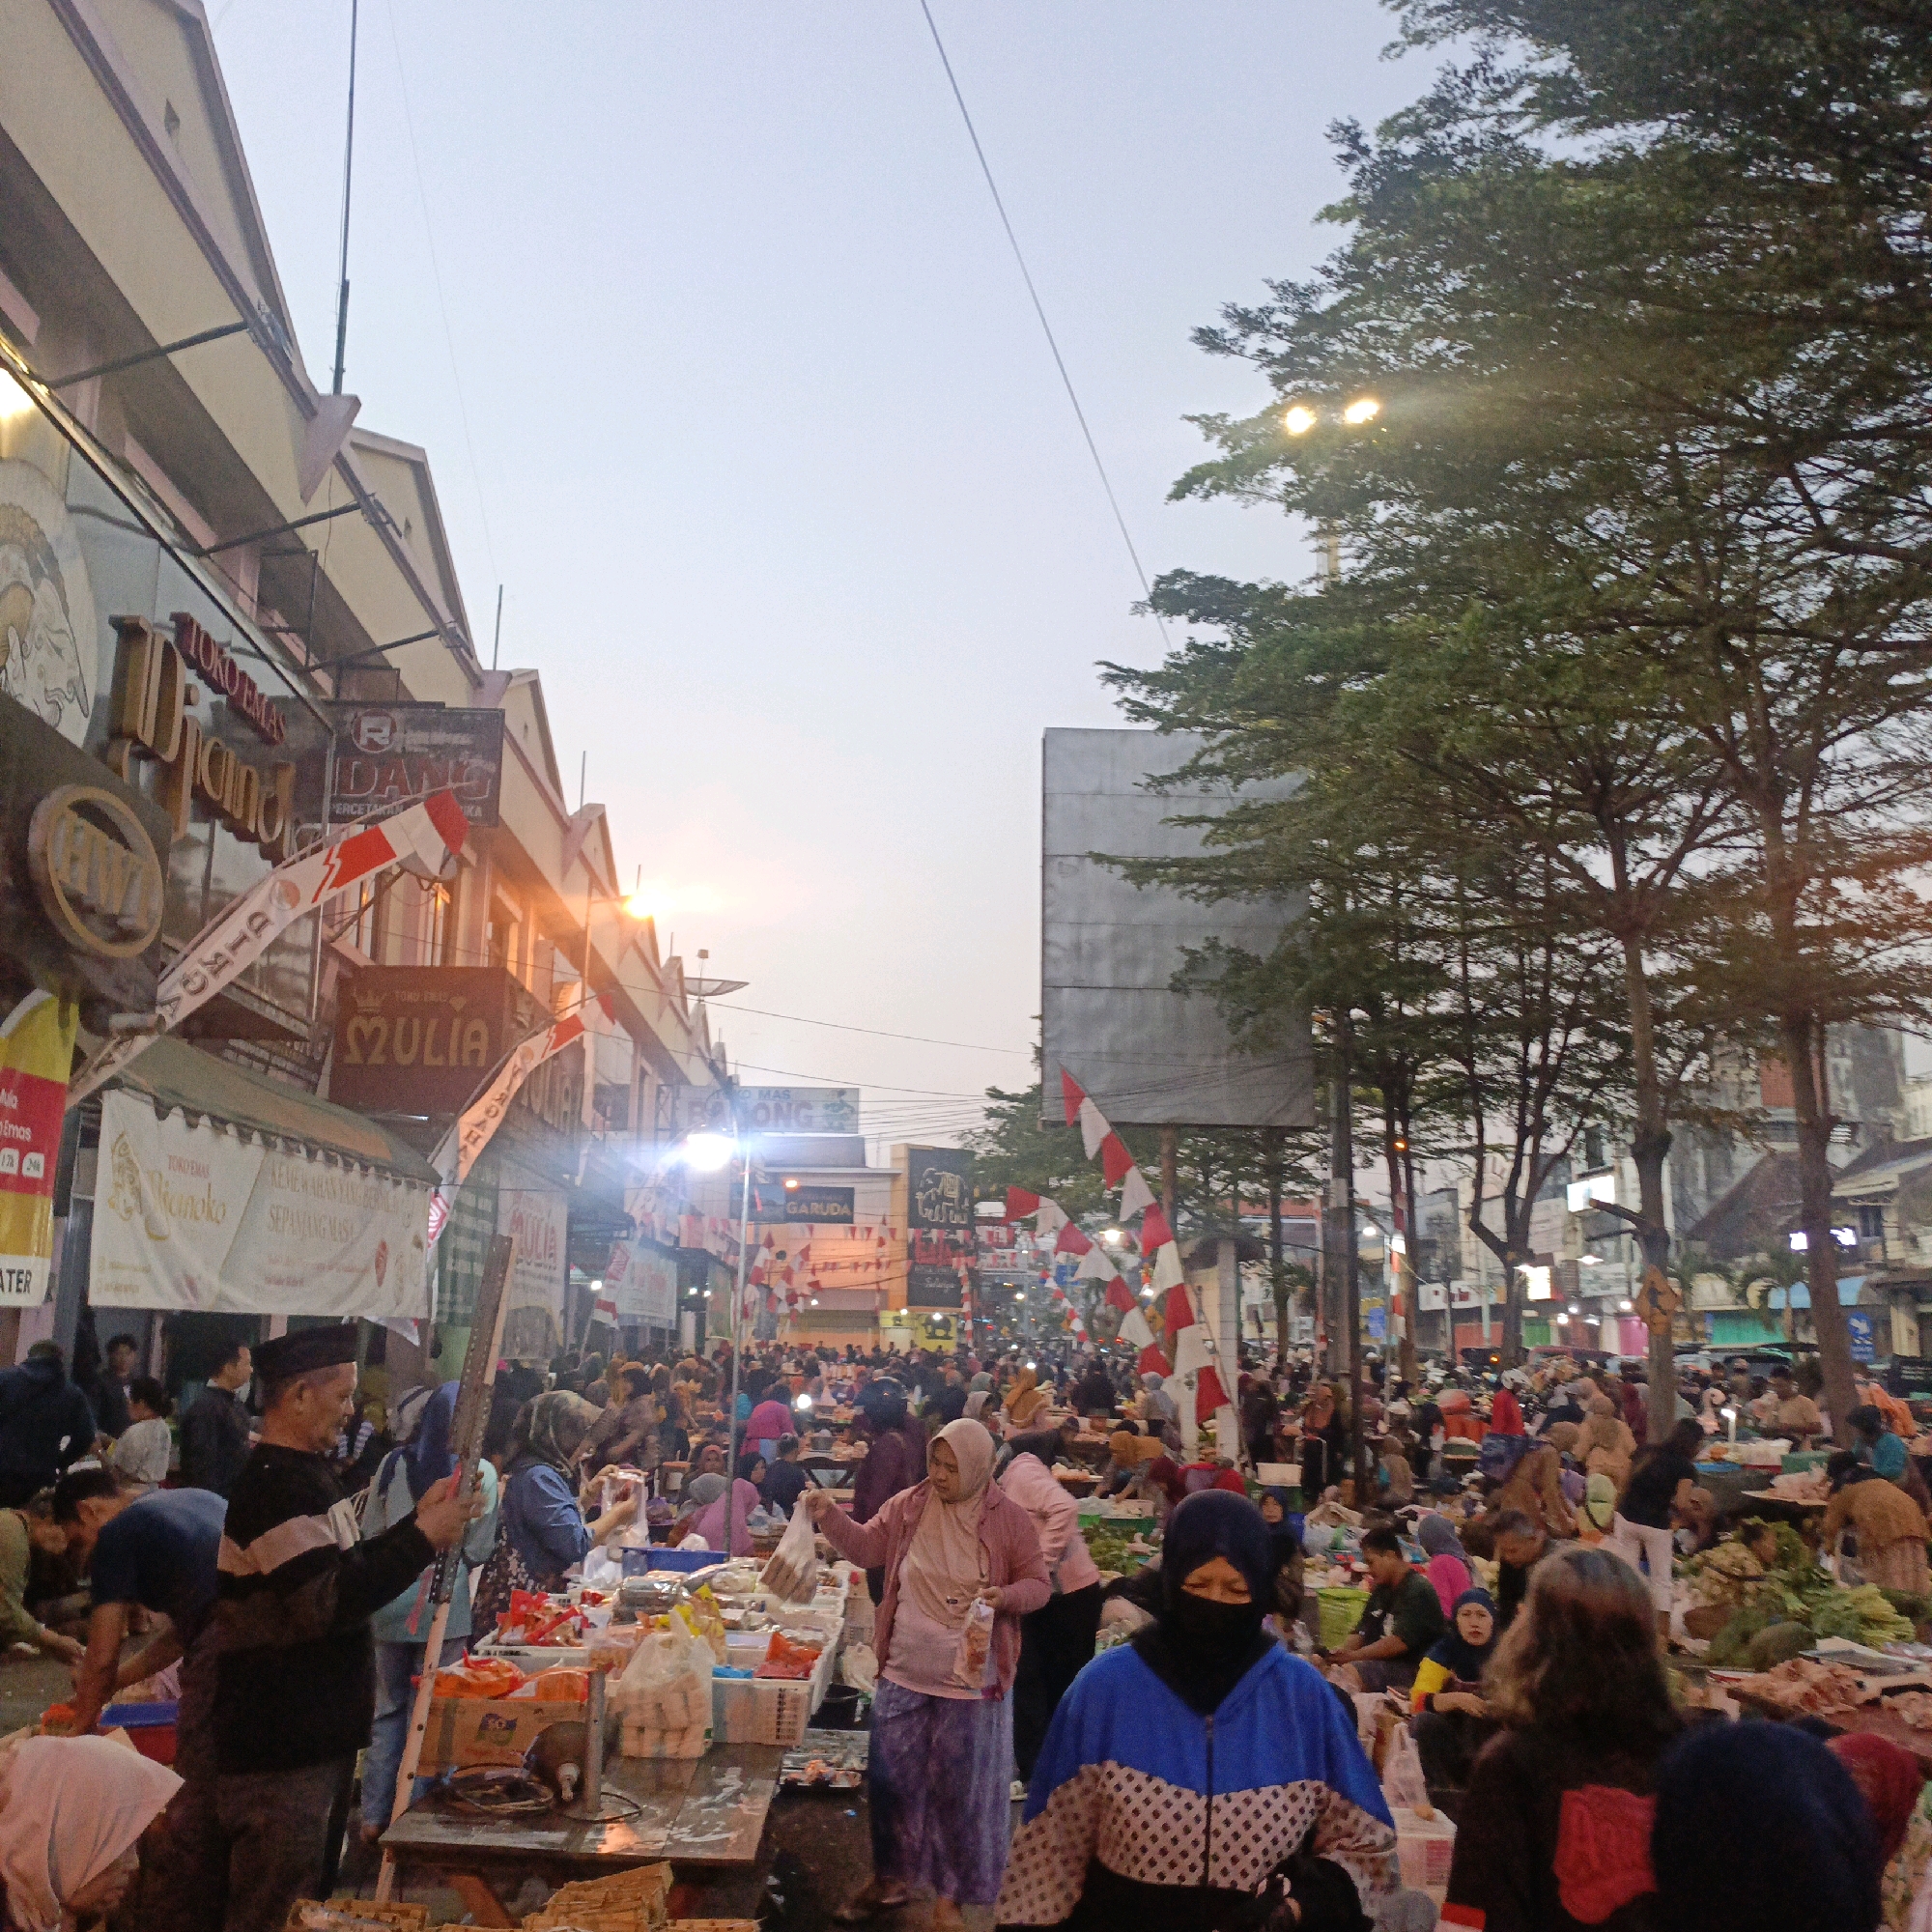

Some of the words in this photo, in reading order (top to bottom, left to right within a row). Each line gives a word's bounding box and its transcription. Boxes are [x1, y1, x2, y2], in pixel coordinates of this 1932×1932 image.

[172, 612, 240, 696] TOKO
[234, 673, 286, 745] EMAS
[108, 614, 297, 858] Djano
[331, 803, 404, 817] ERCETAKAN
[344, 1015, 490, 1066] MULIA
[715, 1089, 753, 1100] TKO
[757, 1089, 791, 1100] MAS
[687, 1100, 813, 1128] BAONG
[785, 1201, 852, 1216] GARUDA
